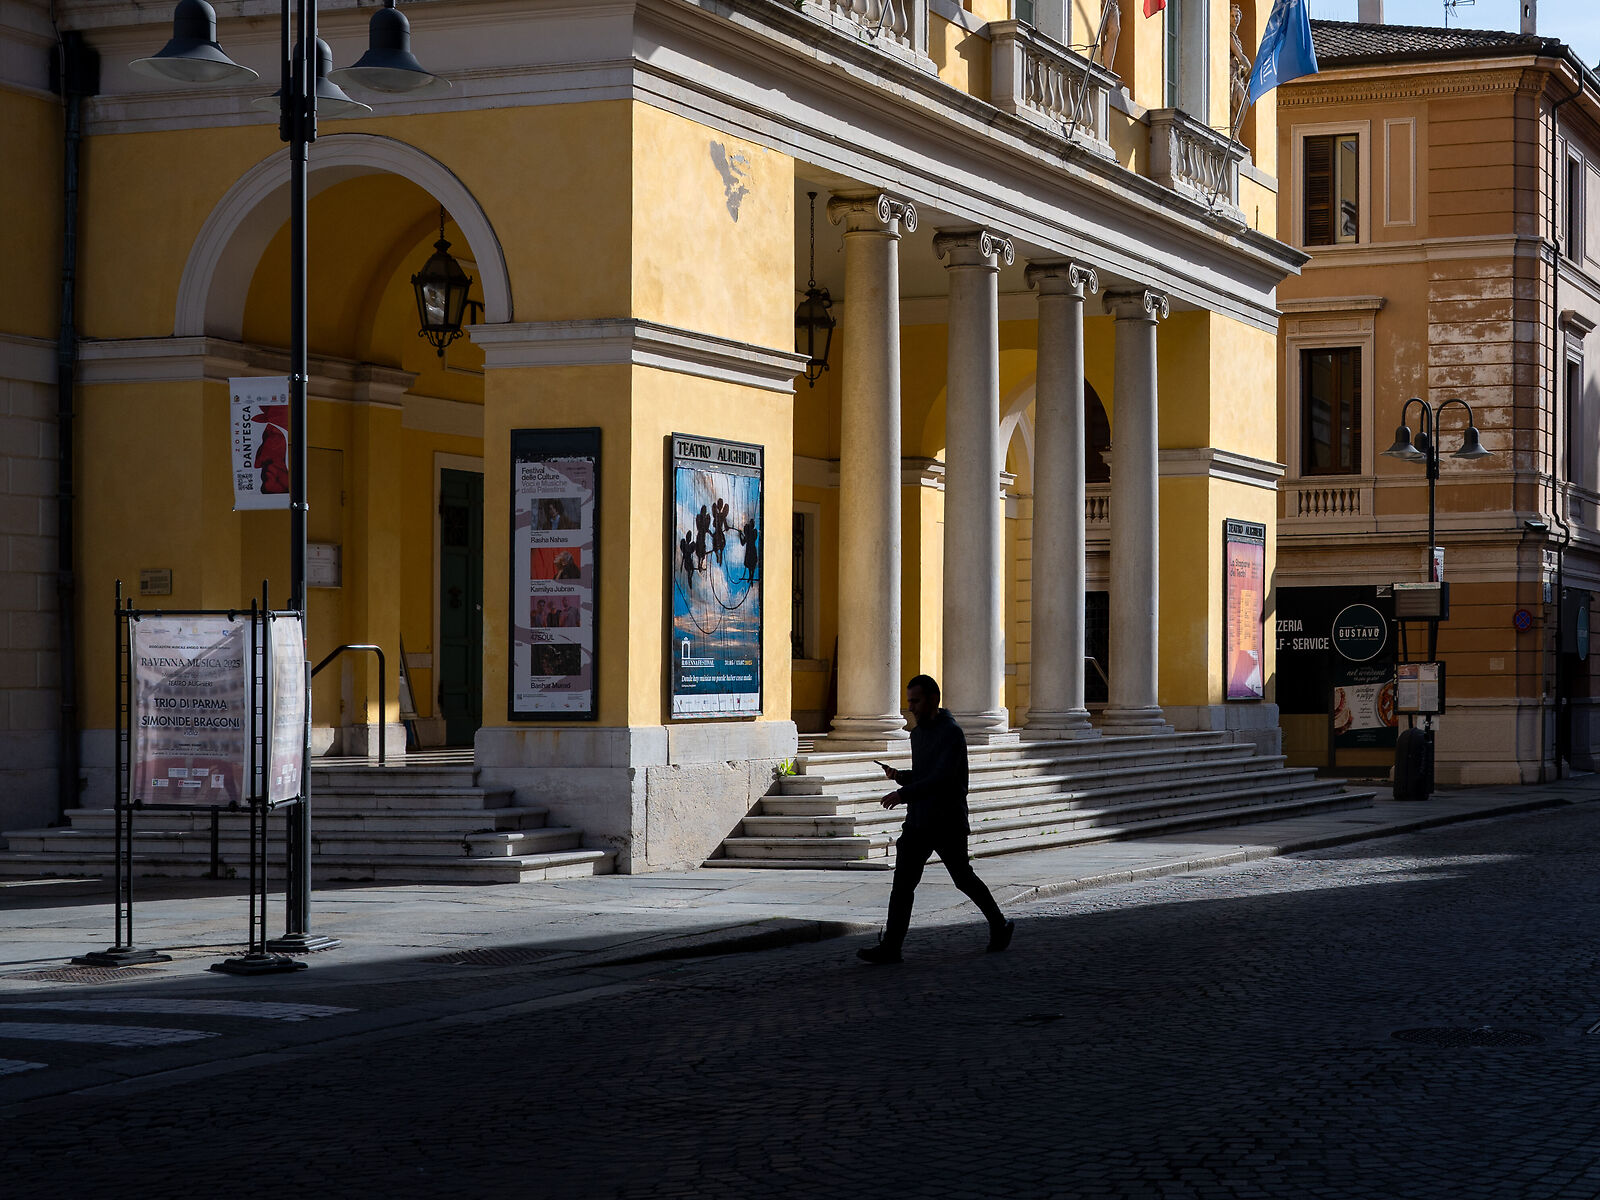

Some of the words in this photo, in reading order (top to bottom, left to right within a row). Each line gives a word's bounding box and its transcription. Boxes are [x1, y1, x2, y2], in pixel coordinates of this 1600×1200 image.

[242, 406, 252, 468] DANTESCA
[677, 441, 711, 458] TEATRO
[718, 448, 757, 465] ALIGHIERI
[1292, 638, 1330, 650] SERVICE
[141, 657, 185, 667] RAVENNA
[187, 658, 221, 668] MUSICA
[224, 659, 241, 669] 2025
[154, 698, 176, 708] TRIO
[180, 699, 189, 708] DI
[193, 699, 227, 709] PARMA
[142, 716, 190, 726] SIMONIDE
[194, 717, 240, 727] BRACONI
